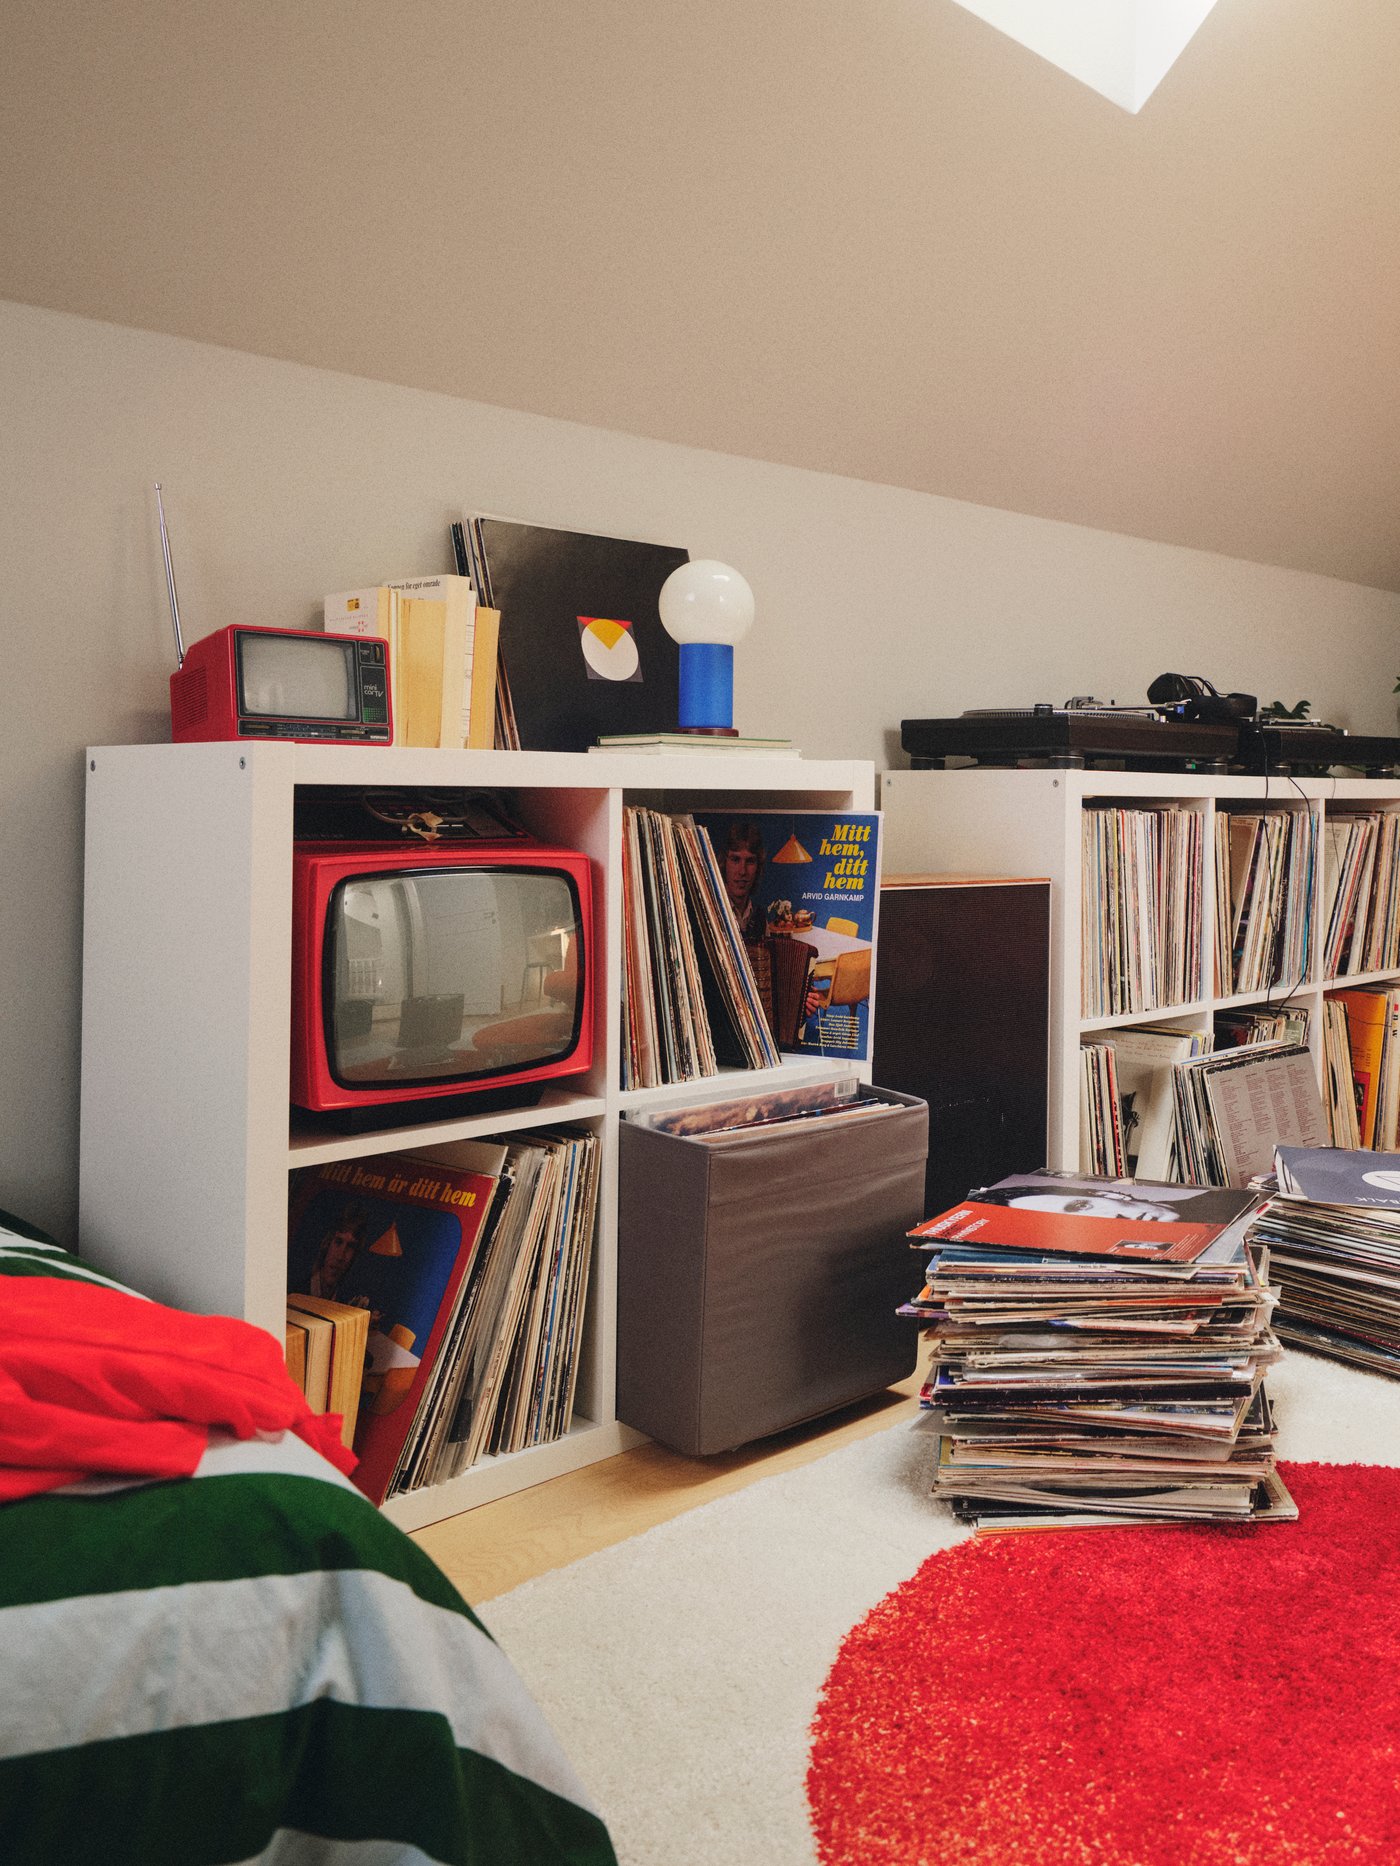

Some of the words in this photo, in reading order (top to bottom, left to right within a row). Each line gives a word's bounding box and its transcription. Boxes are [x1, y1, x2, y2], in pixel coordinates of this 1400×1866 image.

[830, 824, 871, 842] Mitt
[818, 838, 865, 860] hem,
[833, 857, 869, 876] ditt
[823, 871, 865, 890] hem
[801, 892, 823, 900] ARVID
[824, 893, 865, 902] GARNKAMP
[351, 1166, 386, 1190] hem
[387, 1174, 408, 1194] är
[408, 1177, 441, 1201] ditt
[439, 1183, 477, 1208] hem
